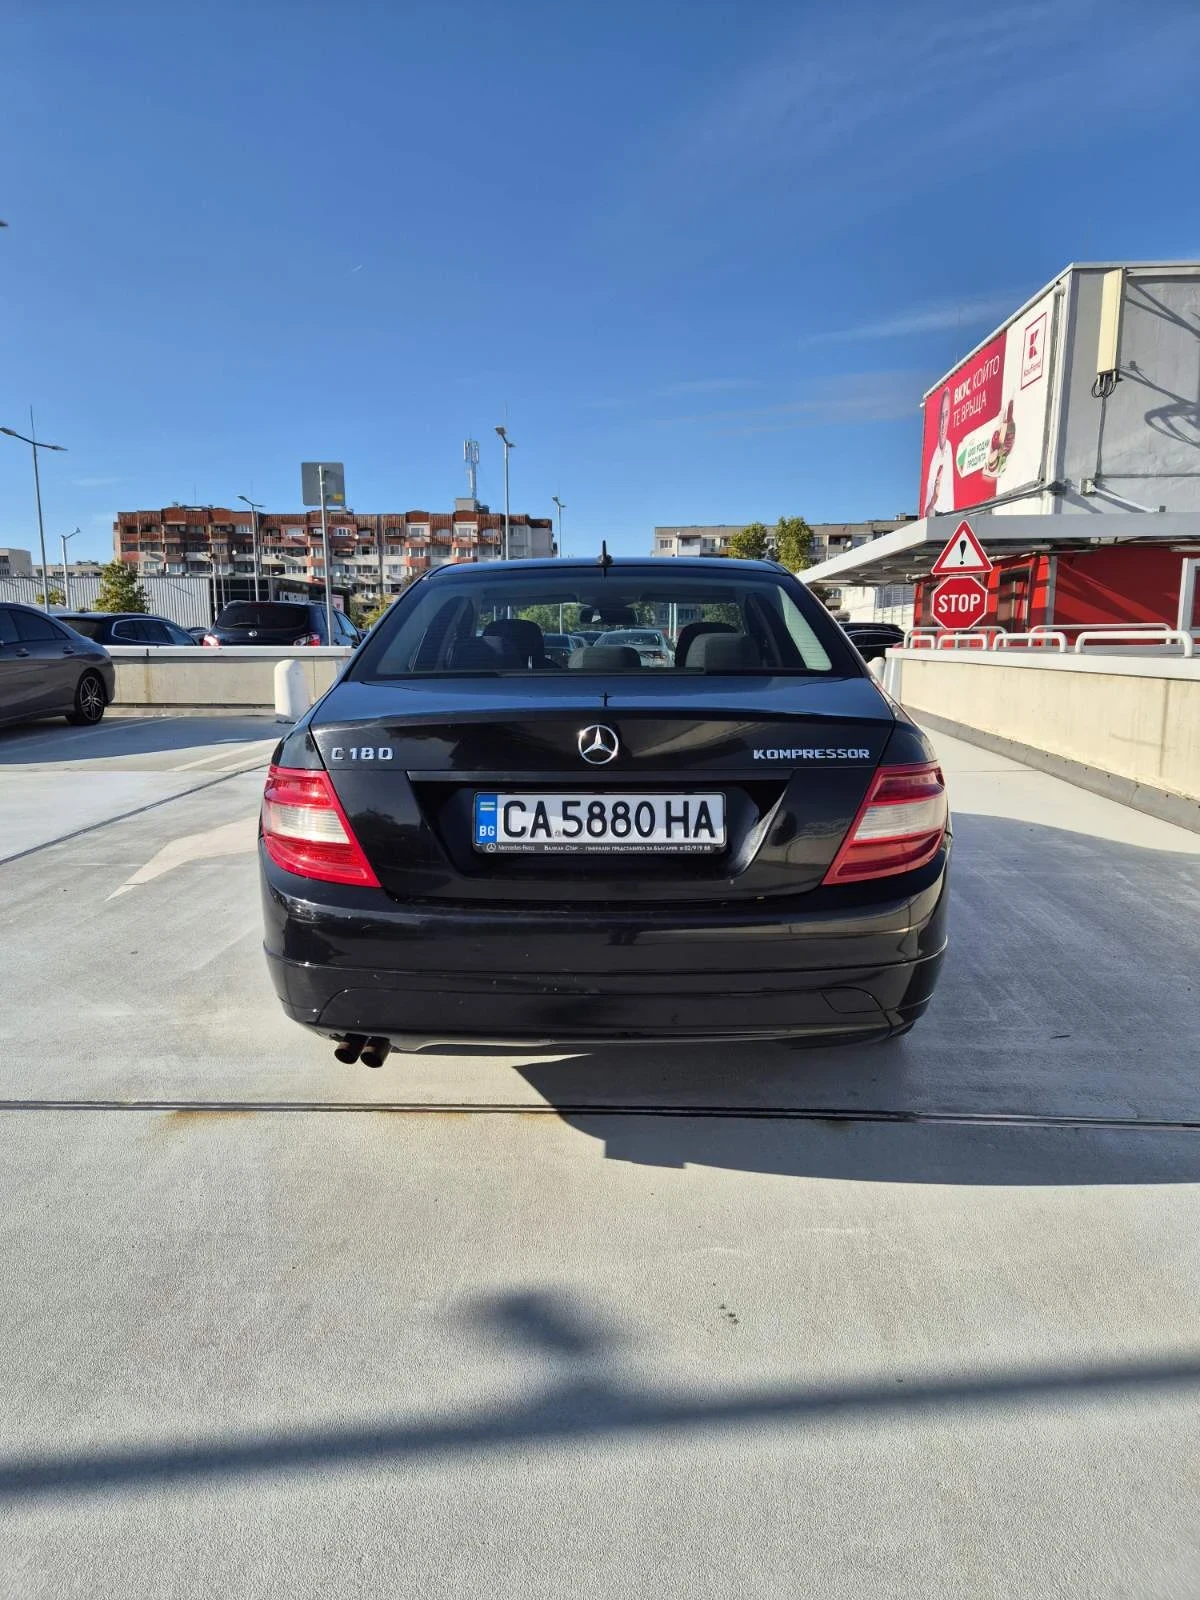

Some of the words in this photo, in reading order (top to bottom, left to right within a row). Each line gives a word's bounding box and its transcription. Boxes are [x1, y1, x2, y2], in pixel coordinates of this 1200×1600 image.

[954, 377, 971, 405] ВКУС
[973, 354, 1000, 390] КОЙТО
[953, 408, 961, 428] ТЕ
[961, 390, 987, 423] ВРЪЩА
[938, 594, 980, 613] STOP
[331, 747, 345, 760] C
[349, 747, 393, 760] 180
[753, 748, 871, 760] KOMPRESSOR
[561, 800, 656, 839] 5880
[479, 825, 496, 837] BG
